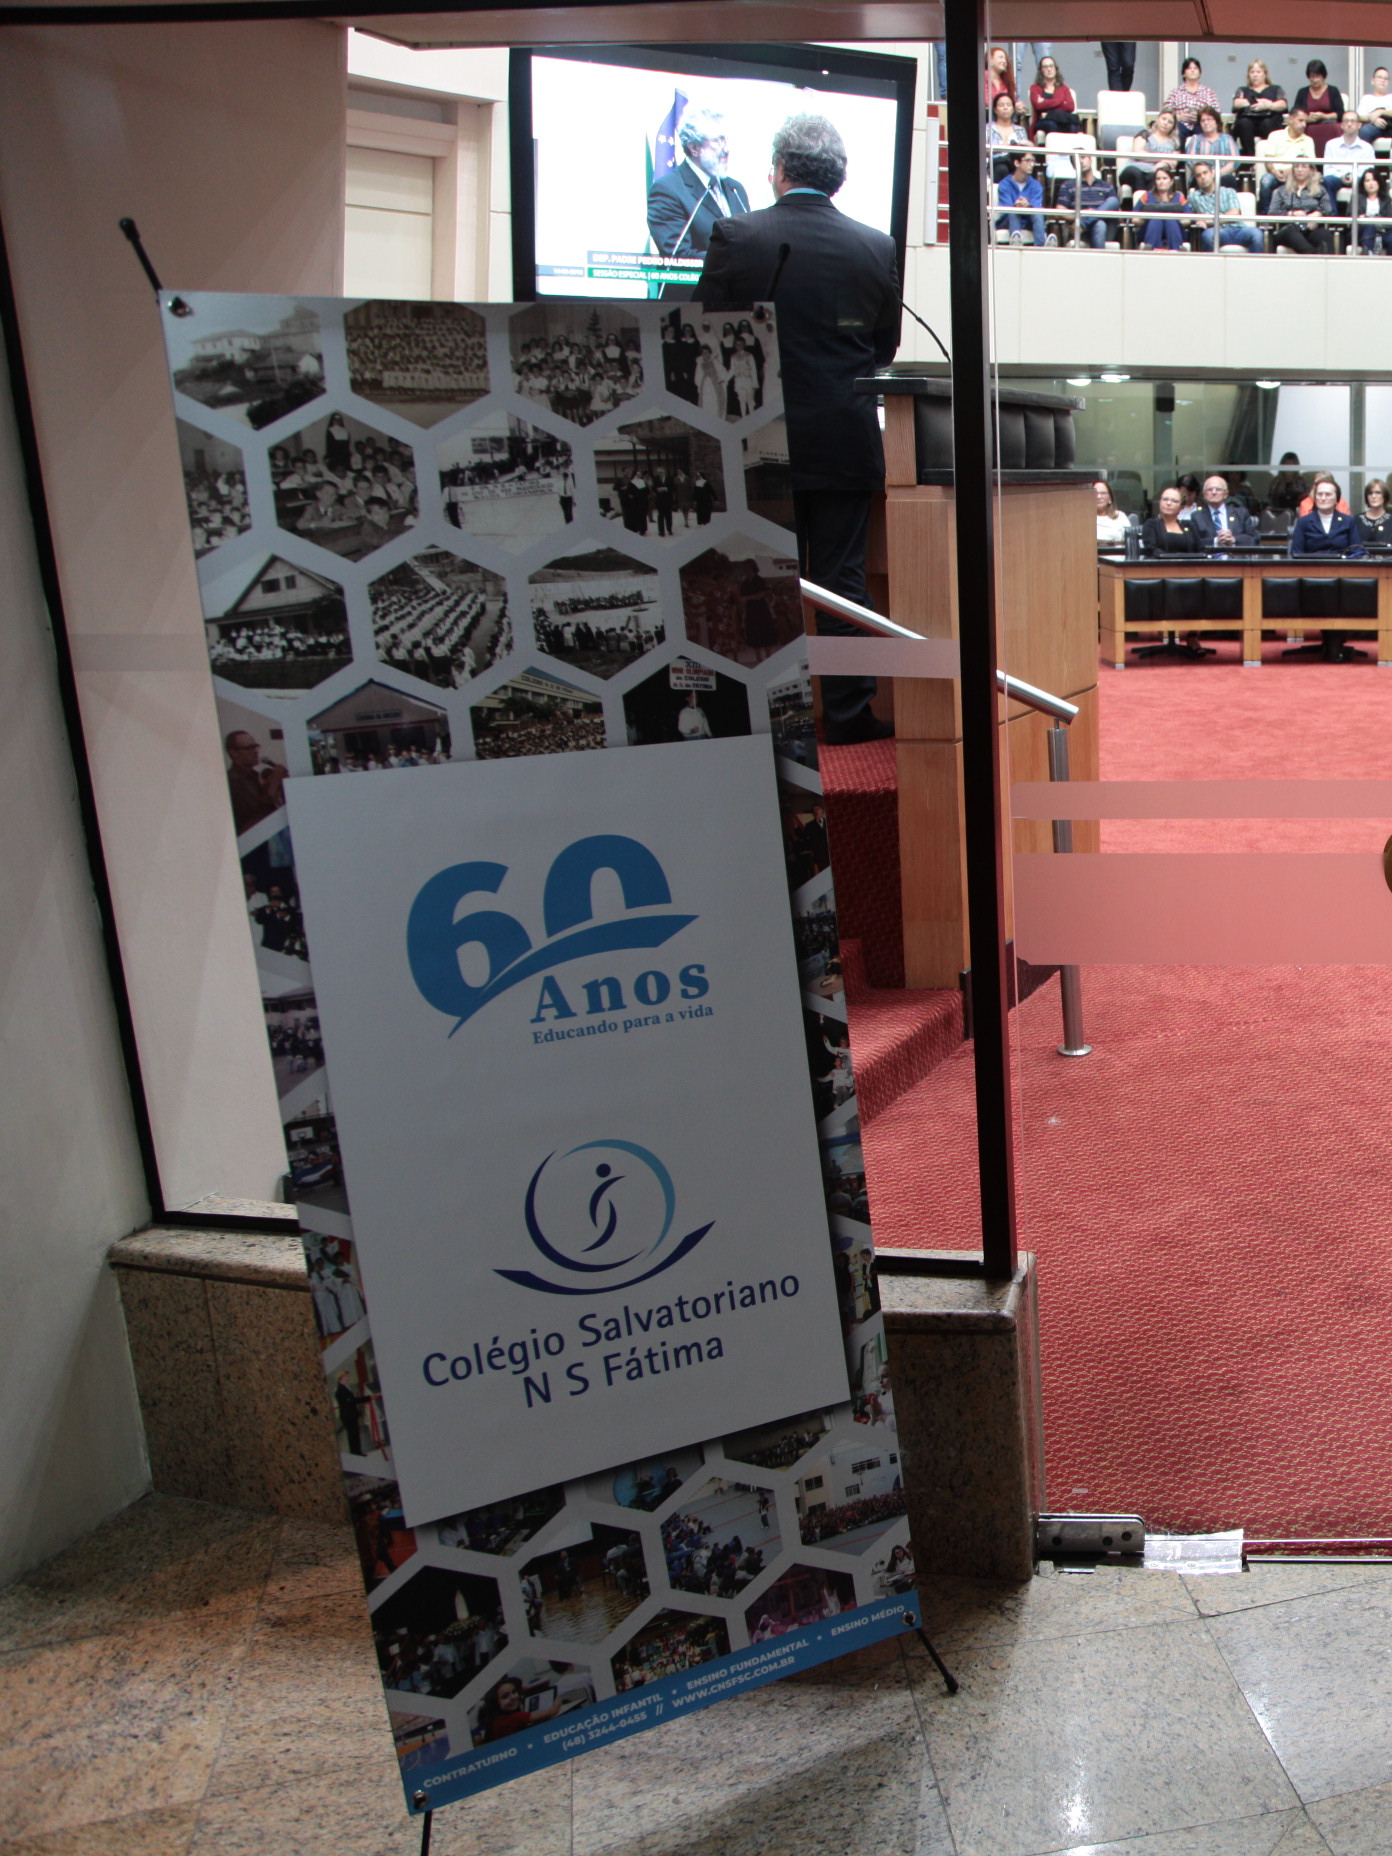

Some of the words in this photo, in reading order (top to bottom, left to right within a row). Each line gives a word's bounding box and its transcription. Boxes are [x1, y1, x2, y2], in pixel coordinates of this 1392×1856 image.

[406, 834, 672, 1018] 60
[529, 964, 710, 1024] Anos
[531, 1019, 618, 1045] Educando
[623, 1015, 661, 1034] para
[665, 1011, 675, 1024] a
[680, 1004, 714, 1022] vida
[422, 1328, 566, 1387] Colégio
[577, 1274, 801, 1347] Salvatoriano
[522, 1371, 552, 1409] N
[565, 1362, 590, 1397] S
[603, 1335, 724, 1387] Fátima
[422, 1747, 518, 1789] CONTRATURNO
[543, 1710, 610, 1744] EDUCAÇÃO
[611, 1692, 664, 1719] INFANTIL
[686, 1668, 728, 1690] ENSINO
[729, 1638, 810, 1674] FUNDAMENTAL
[831, 1616, 869, 1637] ENSINO
[871, 1604, 905, 1623] MÉDIO
[562, 1735, 586, 1752] (48)
[588, 1710, 648, 1741] 3244-0455
[671, 1655, 796, 1709] WWW.CNSFSC.COM.BR
